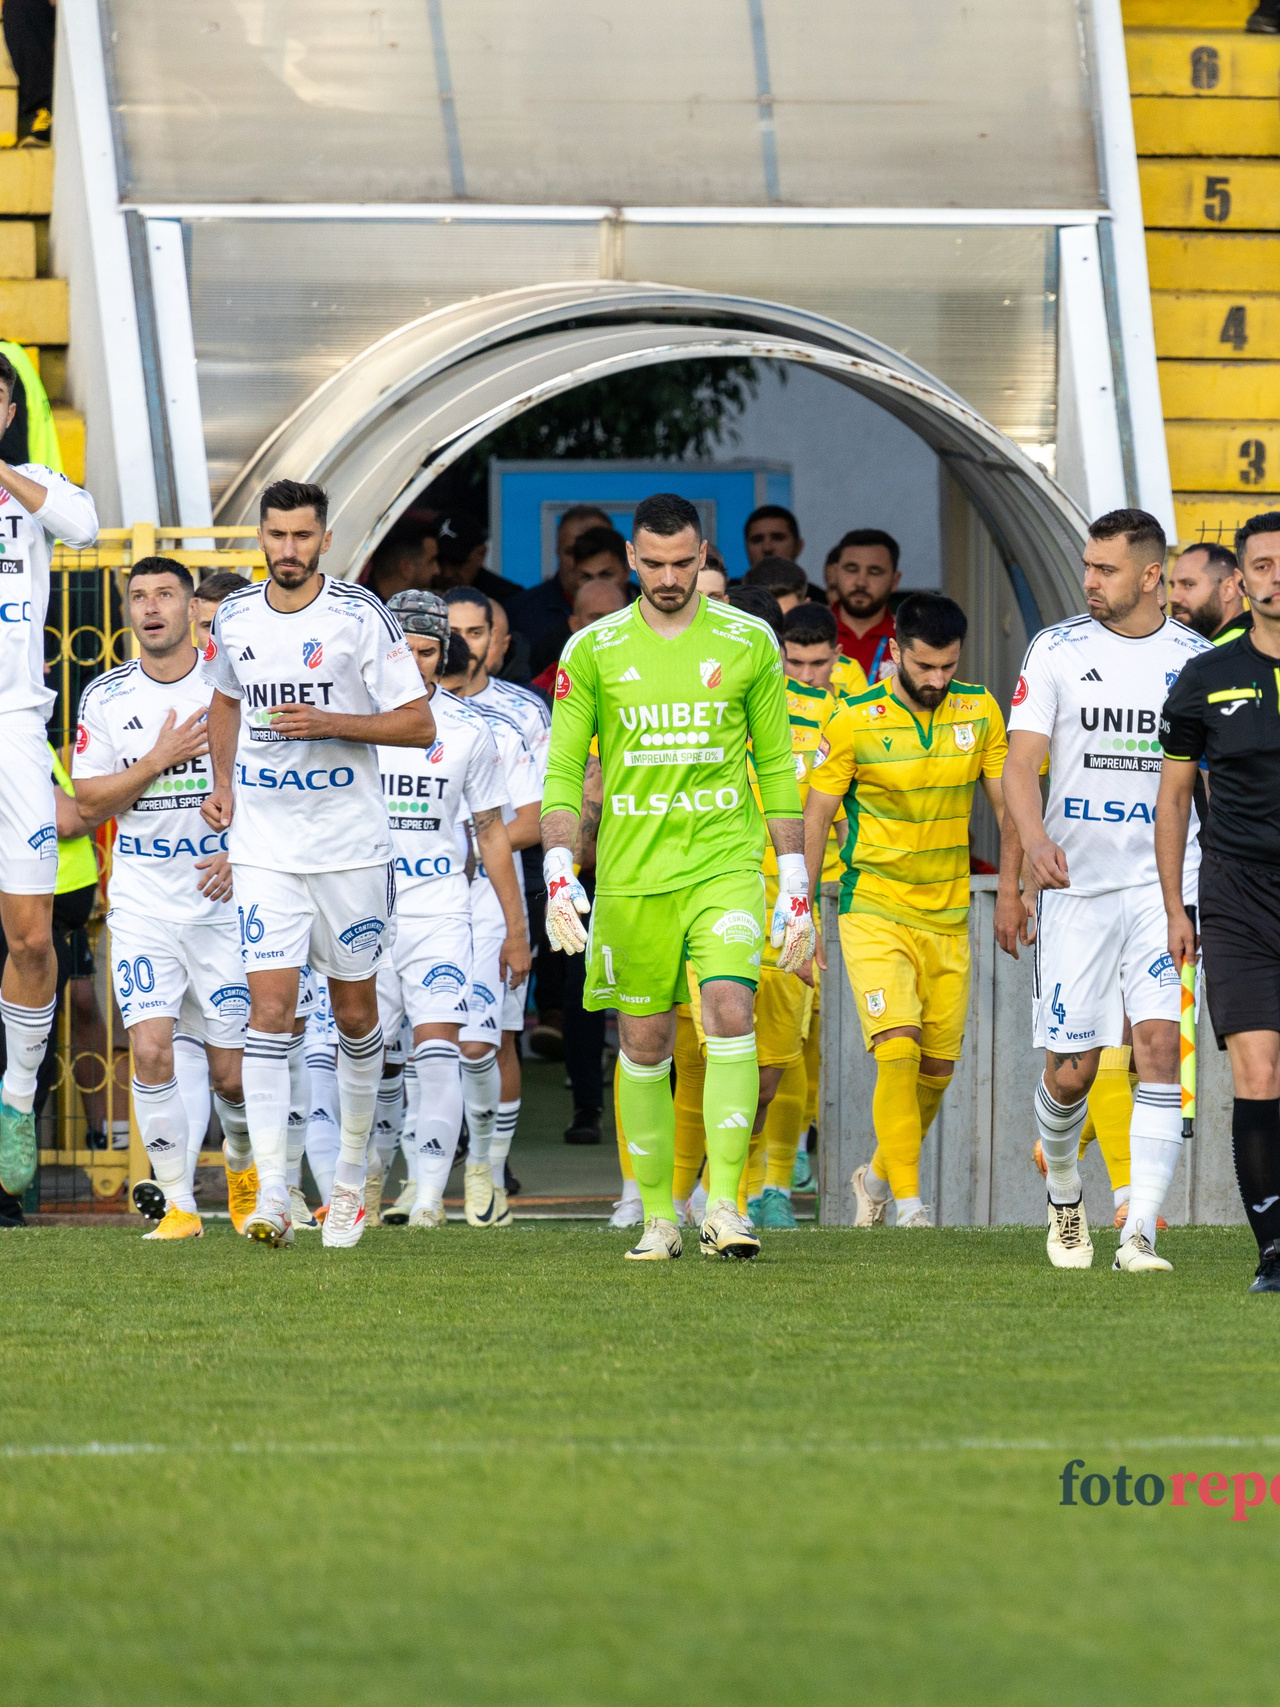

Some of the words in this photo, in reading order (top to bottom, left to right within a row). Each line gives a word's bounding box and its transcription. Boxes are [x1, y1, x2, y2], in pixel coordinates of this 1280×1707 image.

[1190, 46, 1220, 89] 6
[1204, 176, 1231, 222] 5
[1220, 306, 1247, 351] 4
[1238, 440, 1266, 484] 3
[619, 701, 728, 731] UNIBET
[681, 752, 702, 763] SPRE
[705, 751, 719, 761] 0%
[611, 787, 738, 816] ELSACO
[401, 819, 422, 830] SPRE
[423, 819, 435, 830] 0%
[238, 904, 265, 945] 16
[254, 950, 285, 959] Vestra
[1150, 961, 1164, 976] FIVE
[117, 956, 155, 997] 30
[138, 1000, 167, 1010] Vestra
[619, 992, 650, 1003] Vestra
[1052, 983, 1066, 1025] 4
[1066, 1030, 1096, 1040] Vestra
